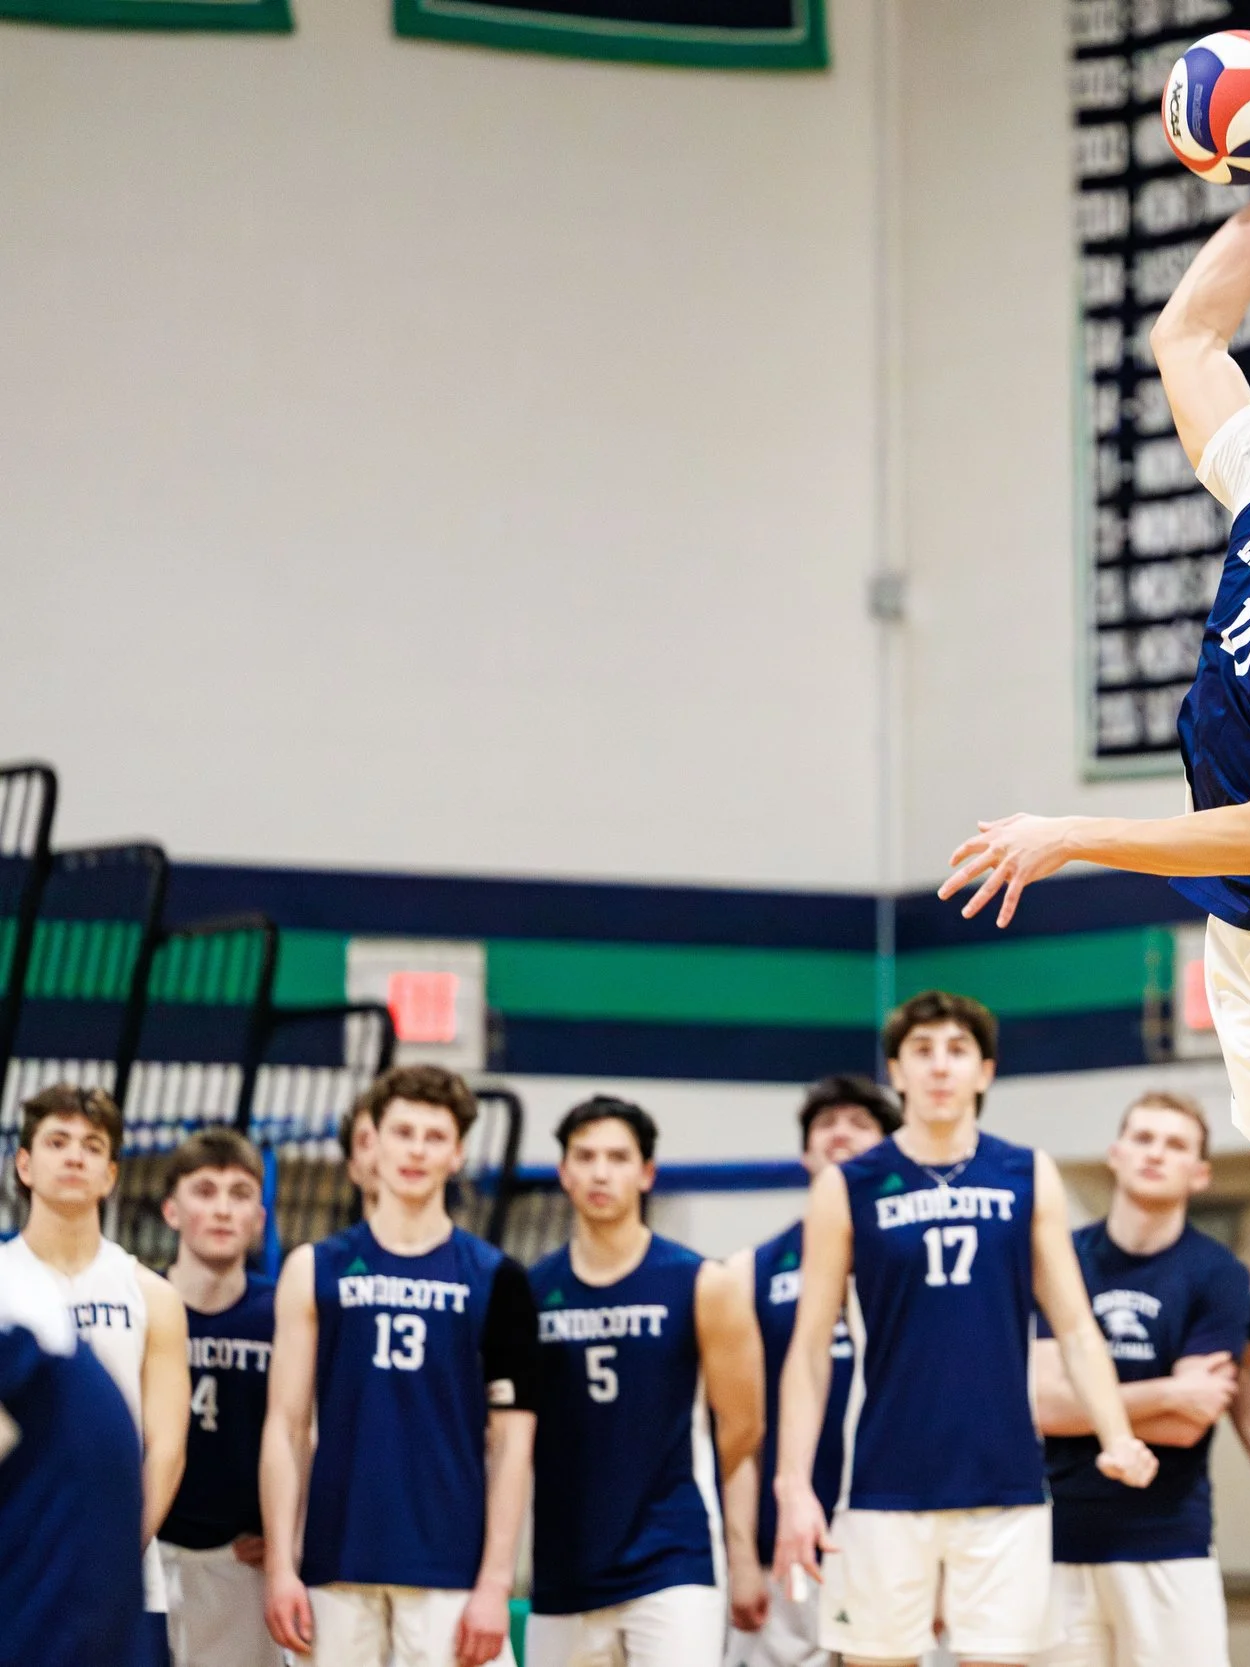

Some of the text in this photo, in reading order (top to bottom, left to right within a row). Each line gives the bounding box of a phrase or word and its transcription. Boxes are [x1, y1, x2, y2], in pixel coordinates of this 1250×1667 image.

[877, 1186, 1016, 1230] ENDICOTT
[923, 1225, 978, 1286] 17
[338, 1274, 471, 1313] ENDICOTT
[372, 1312, 427, 1371] 13
[537, 1304, 669, 1344] ENDICOTT
[191, 1374, 219, 1432] 4
[585, 1345, 619, 1403] 5
